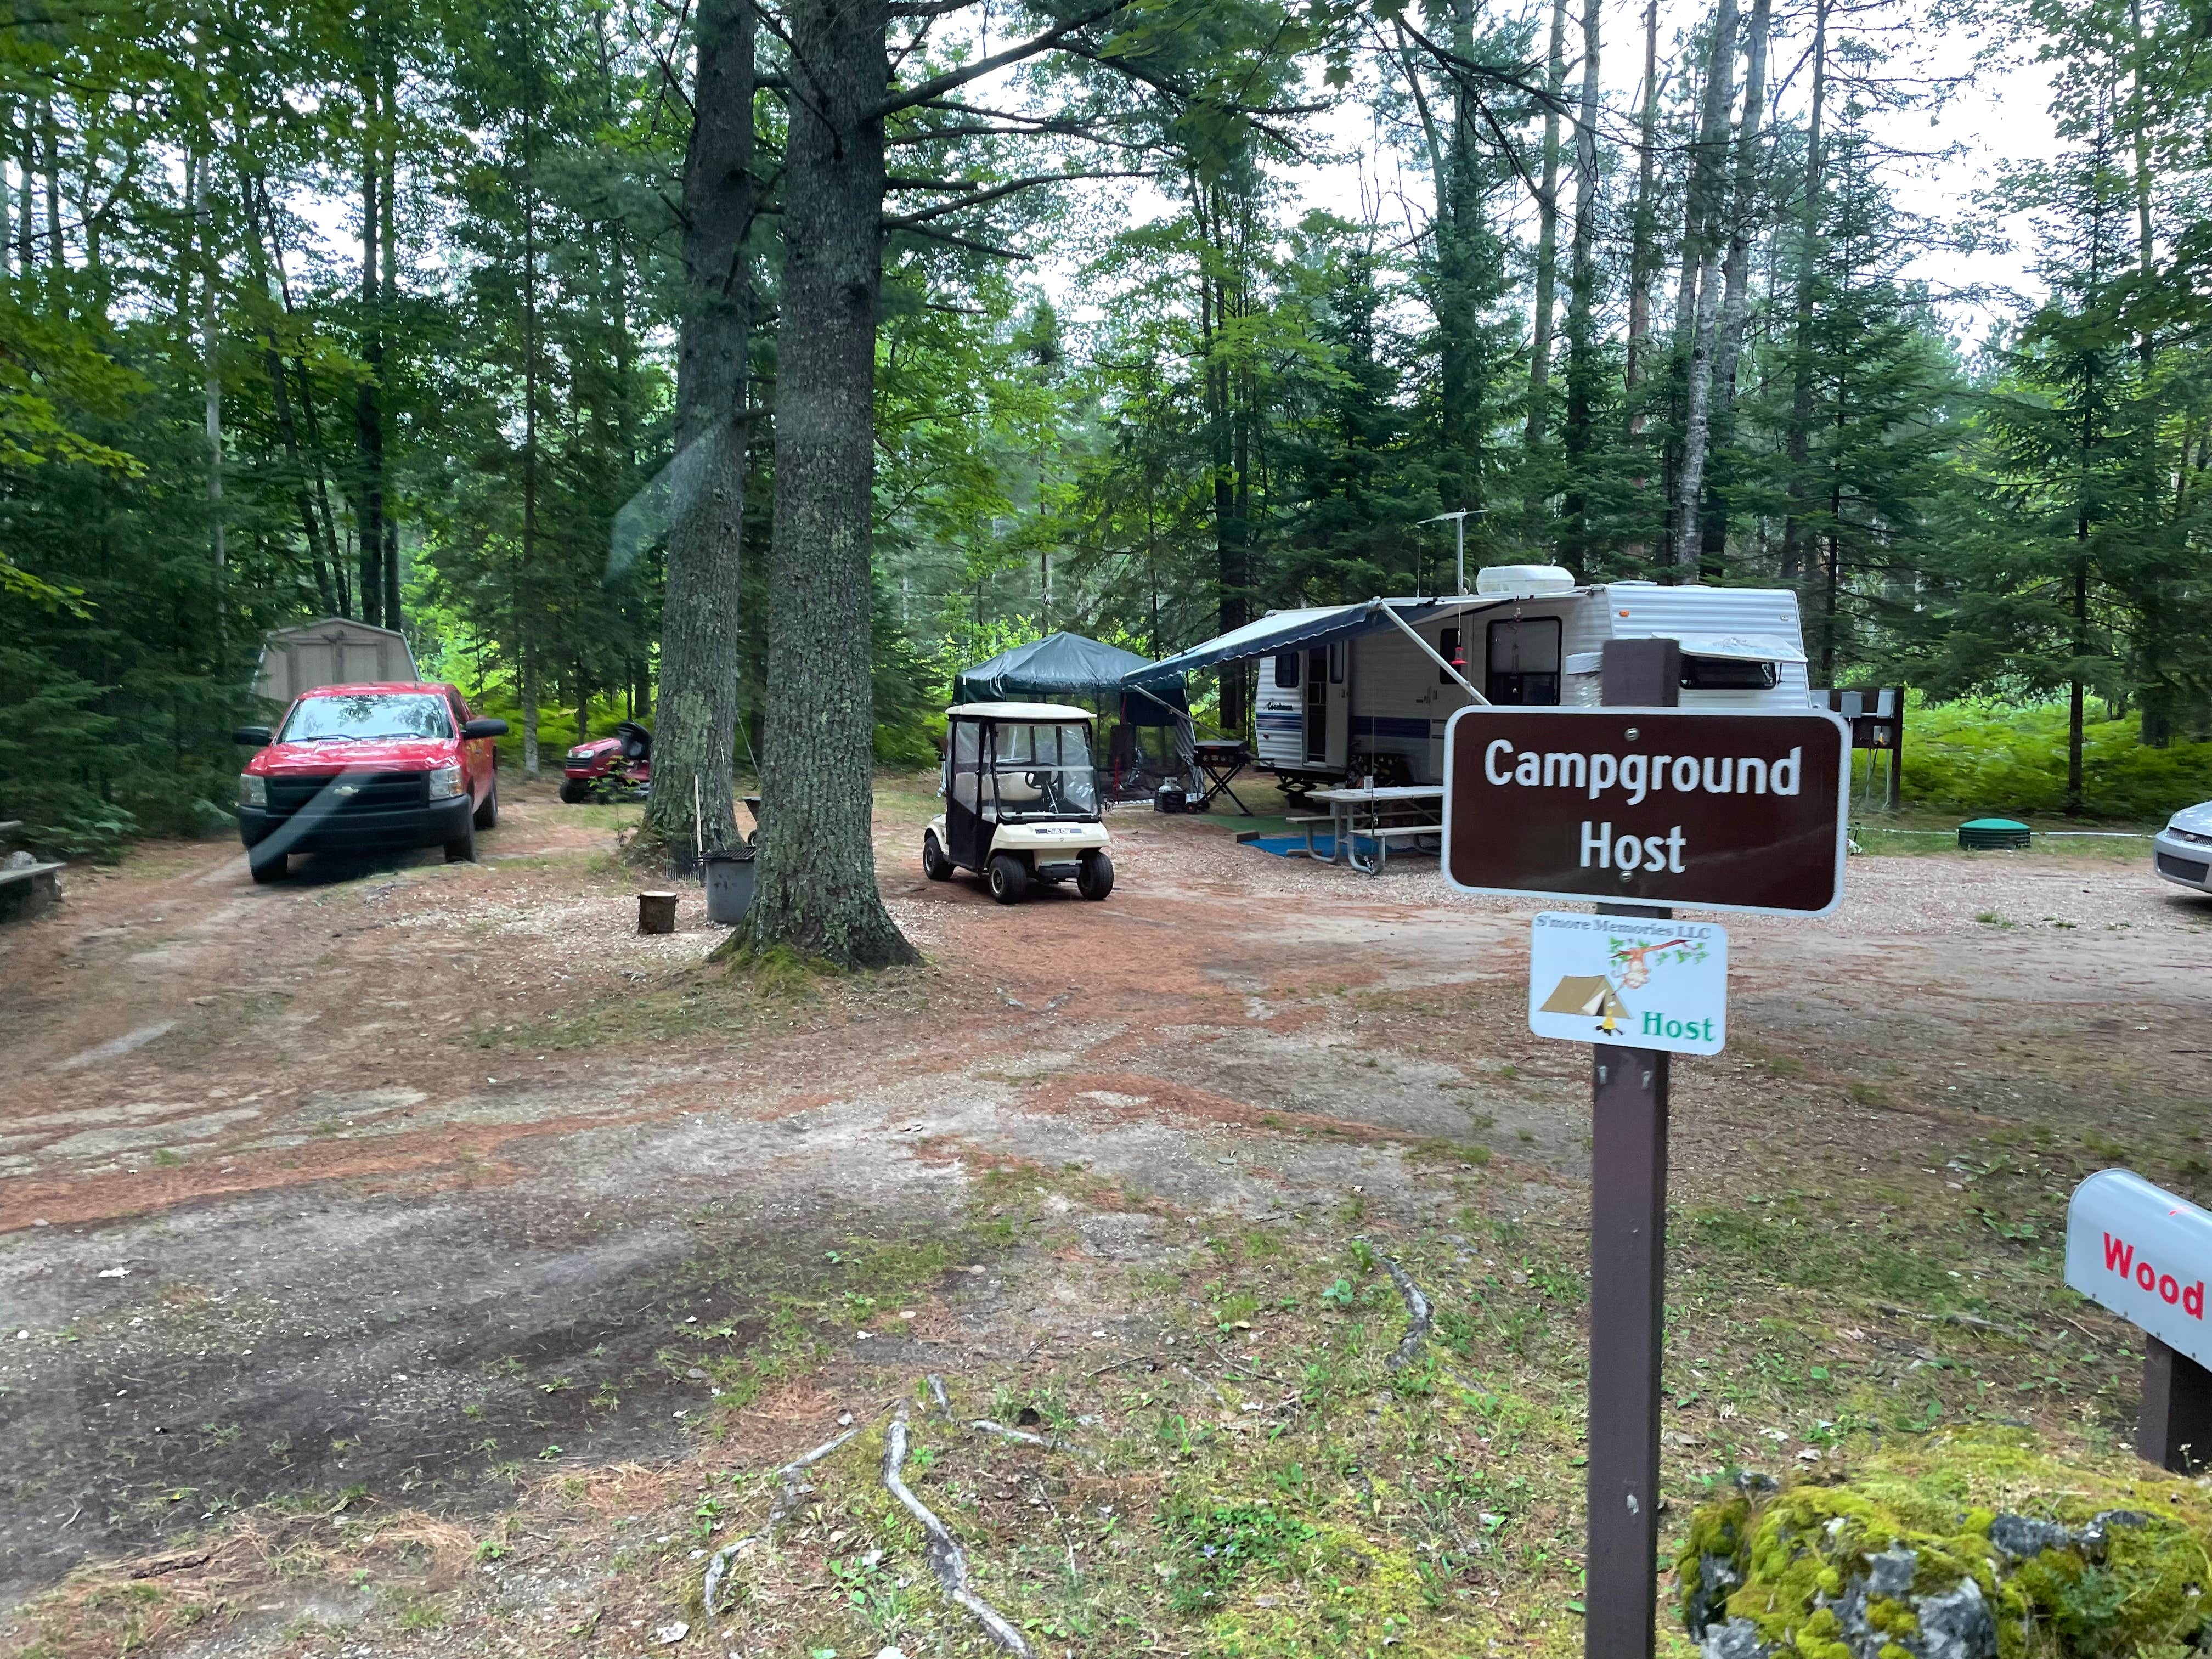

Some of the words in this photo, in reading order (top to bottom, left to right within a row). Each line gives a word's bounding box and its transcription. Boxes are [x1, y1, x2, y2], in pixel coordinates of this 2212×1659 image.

[1485, 739, 1802, 805] Campground
[1580, 821, 1686, 873] Host
[1536, 915, 1590, 930] S'more
[1592, 919, 1674, 937] Memories
[1677, 926, 1711, 939] LLC
[1640, 1011, 1716, 1042] Host
[2103, 1232, 2204, 1321] Wood
